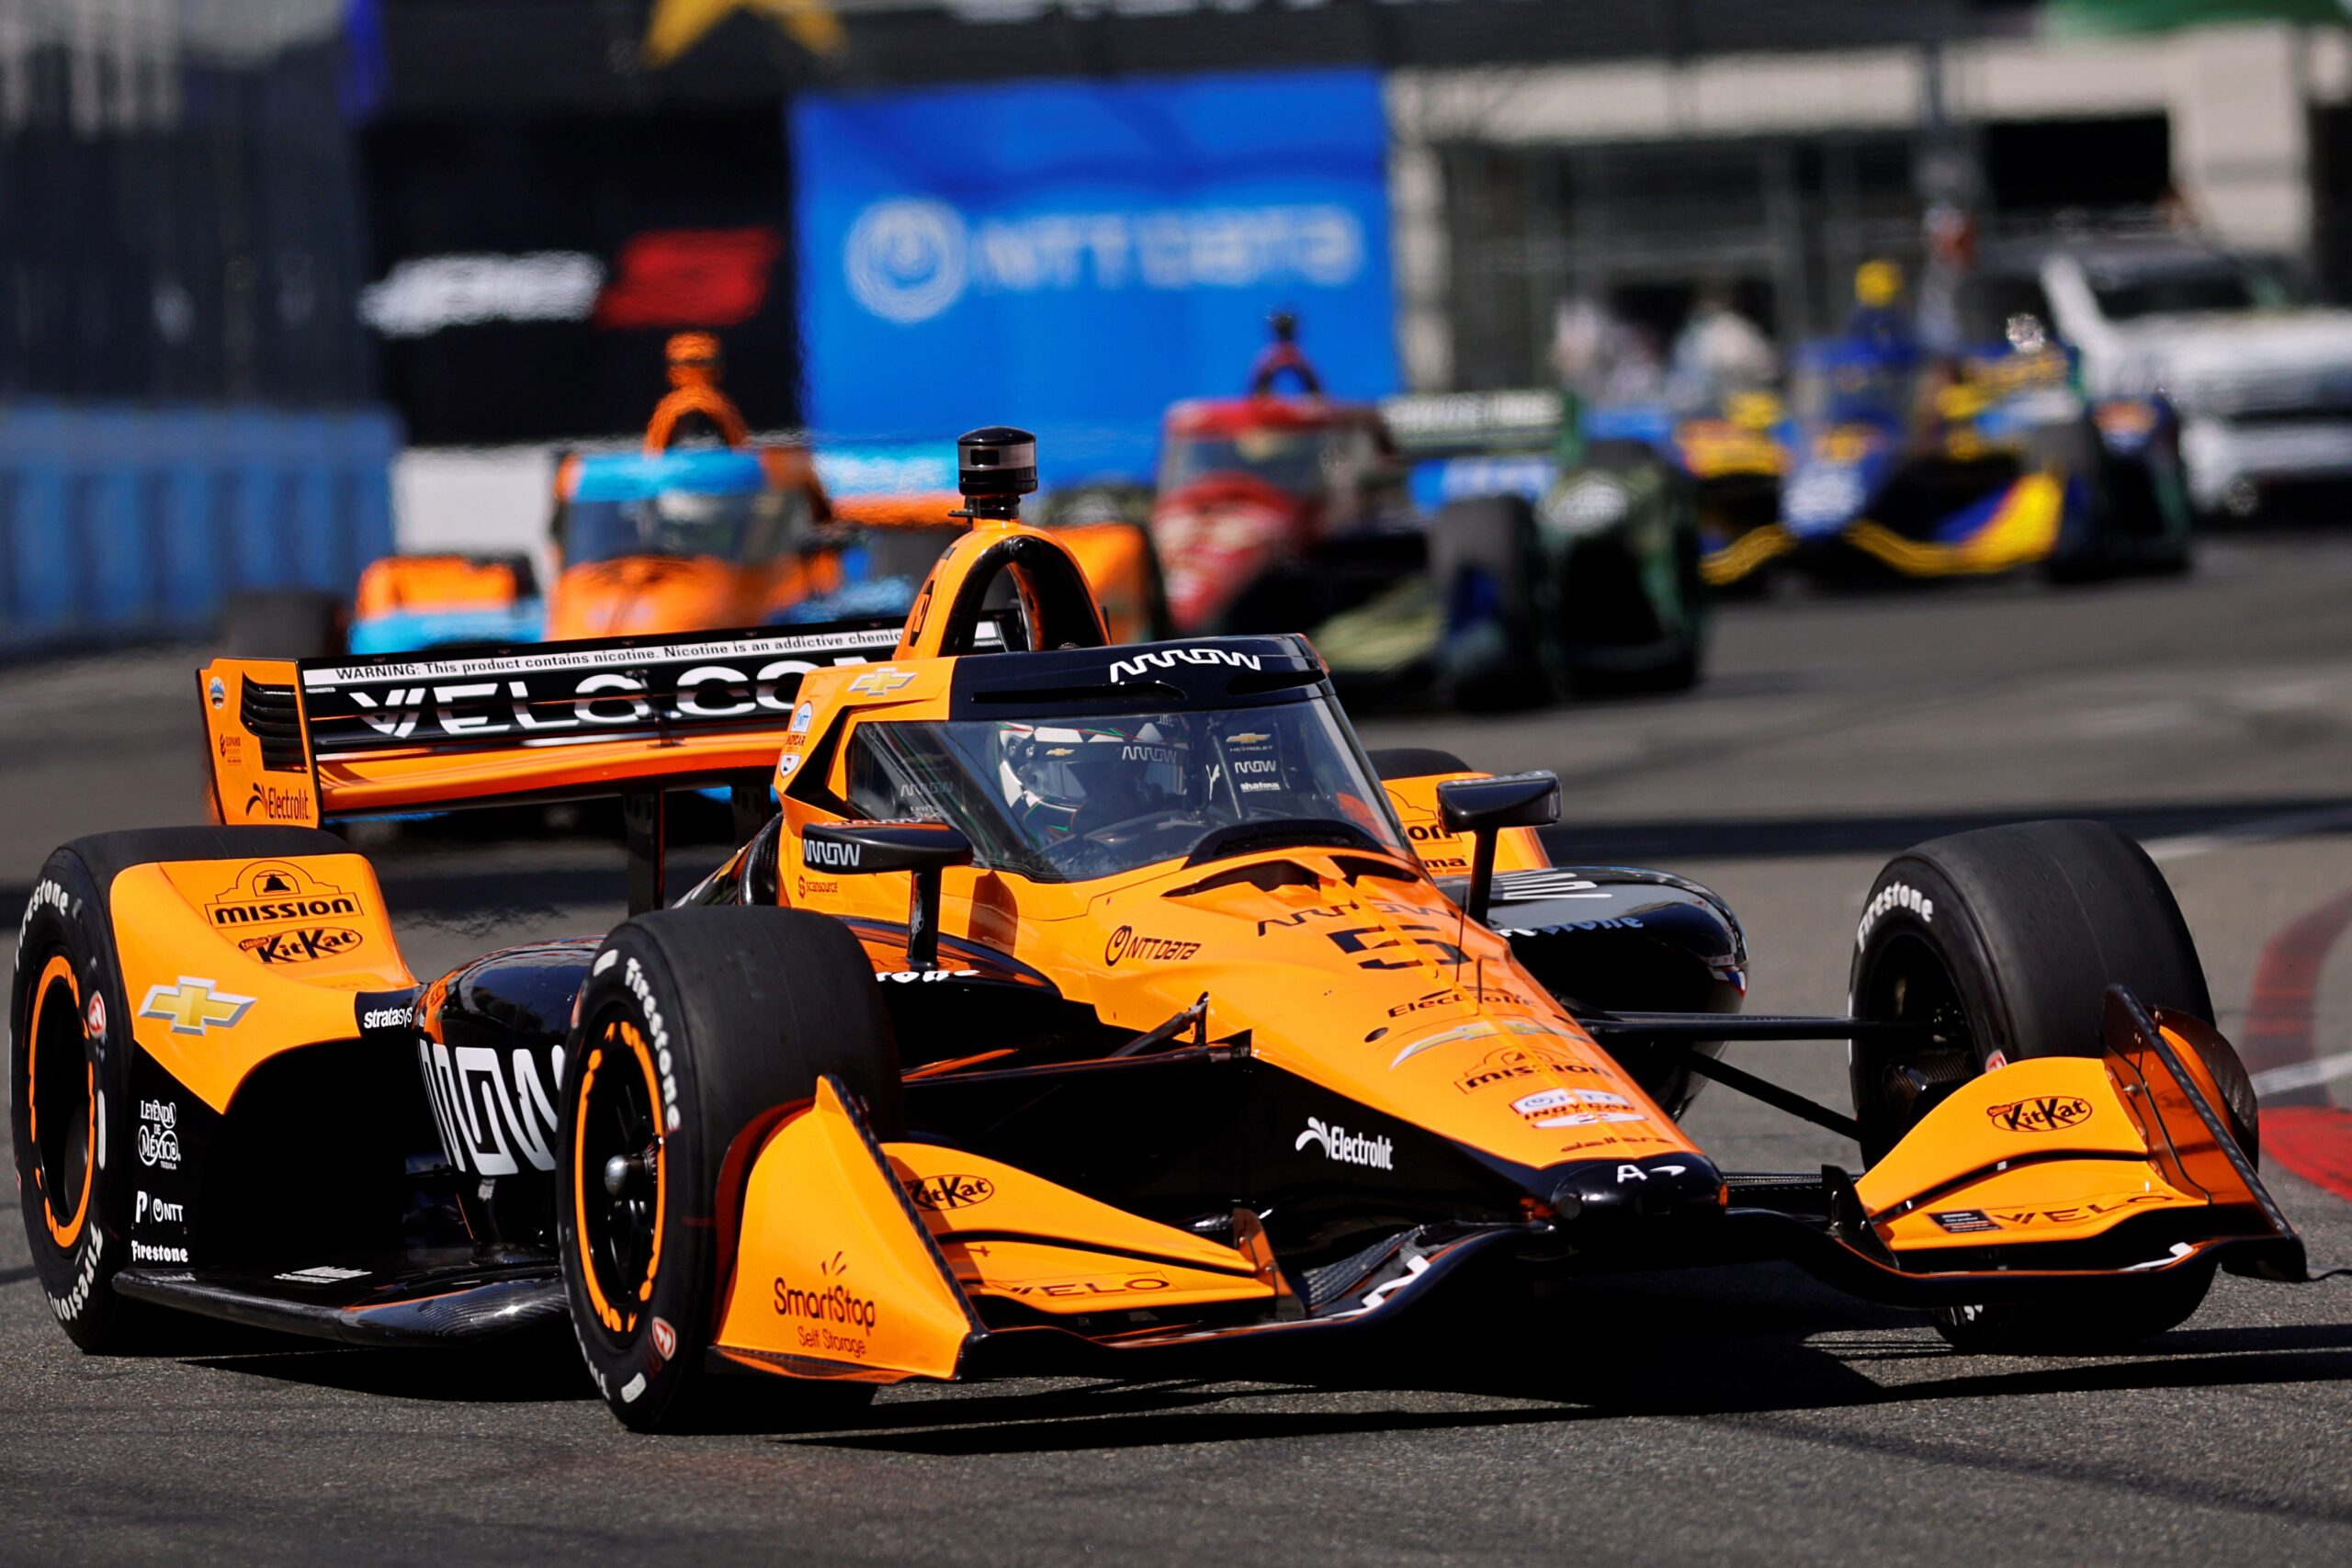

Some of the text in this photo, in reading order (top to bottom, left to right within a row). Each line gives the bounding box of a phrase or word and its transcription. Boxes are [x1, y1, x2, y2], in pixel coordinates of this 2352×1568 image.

[336, 630, 902, 681] WARNING: This product contains nicotine. Nicotine is an addictive chemic
[1110, 649, 1261, 682] ARROW
[348, 655, 868, 738] VELO.CO
[1122, 746, 1177, 763] ARROW
[268, 786, 310, 820] Electrolit
[1857, 881, 1934, 954] Firestone
[255, 929, 356, 964] KitKat
[363, 1006, 413, 1029] stratasys
[1388, 993, 1536, 1018] Electolit
[625, 957, 681, 1131] Firestone
[1465, 1064, 1614, 1089] mision
[153, 1123, 162, 1135] DE
[2002, 1097, 2087, 1132] KitKat
[1329, 1125, 1394, 1171] Electrolit
[164, 1202, 184, 1223] NTT
[1993, 1194, 2175, 1225] VELO
[130, 1239, 189, 1263] Firestone
[774, 1276, 876, 1337] SmartStop
[797, 1325, 866, 1359] Self Storage
